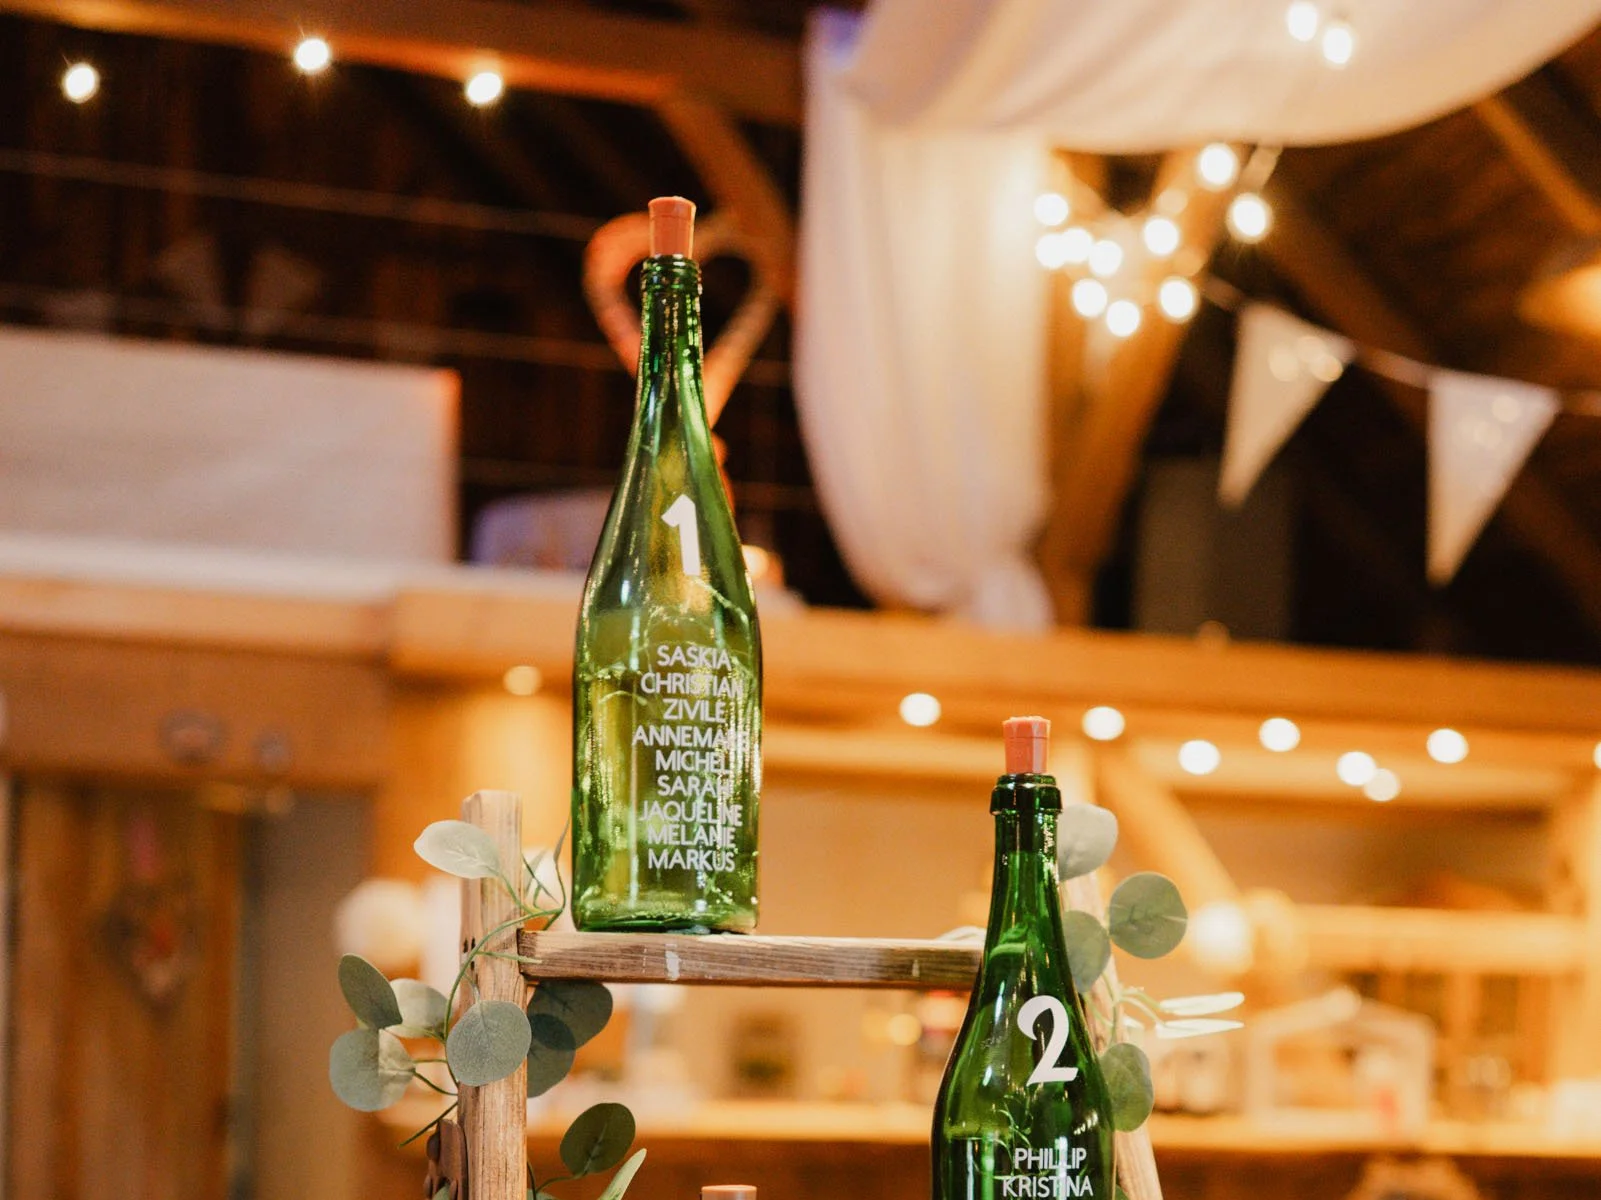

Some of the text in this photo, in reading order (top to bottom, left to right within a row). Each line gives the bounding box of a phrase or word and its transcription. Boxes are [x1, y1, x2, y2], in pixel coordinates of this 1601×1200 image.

[661, 493, 700, 576] 1
[657, 645, 732, 671] SASKIA
[640, 671, 744, 698] CHRISTIAN
[662, 698, 727, 723] ZIVILE
[657, 774, 734, 800] SARAH
[647, 823, 736, 849] MELANIE
[648, 848, 736, 872] MARKUS
[1017, 995, 1079, 1087] 2
[1014, 1147, 1087, 1170] PHILLIP
